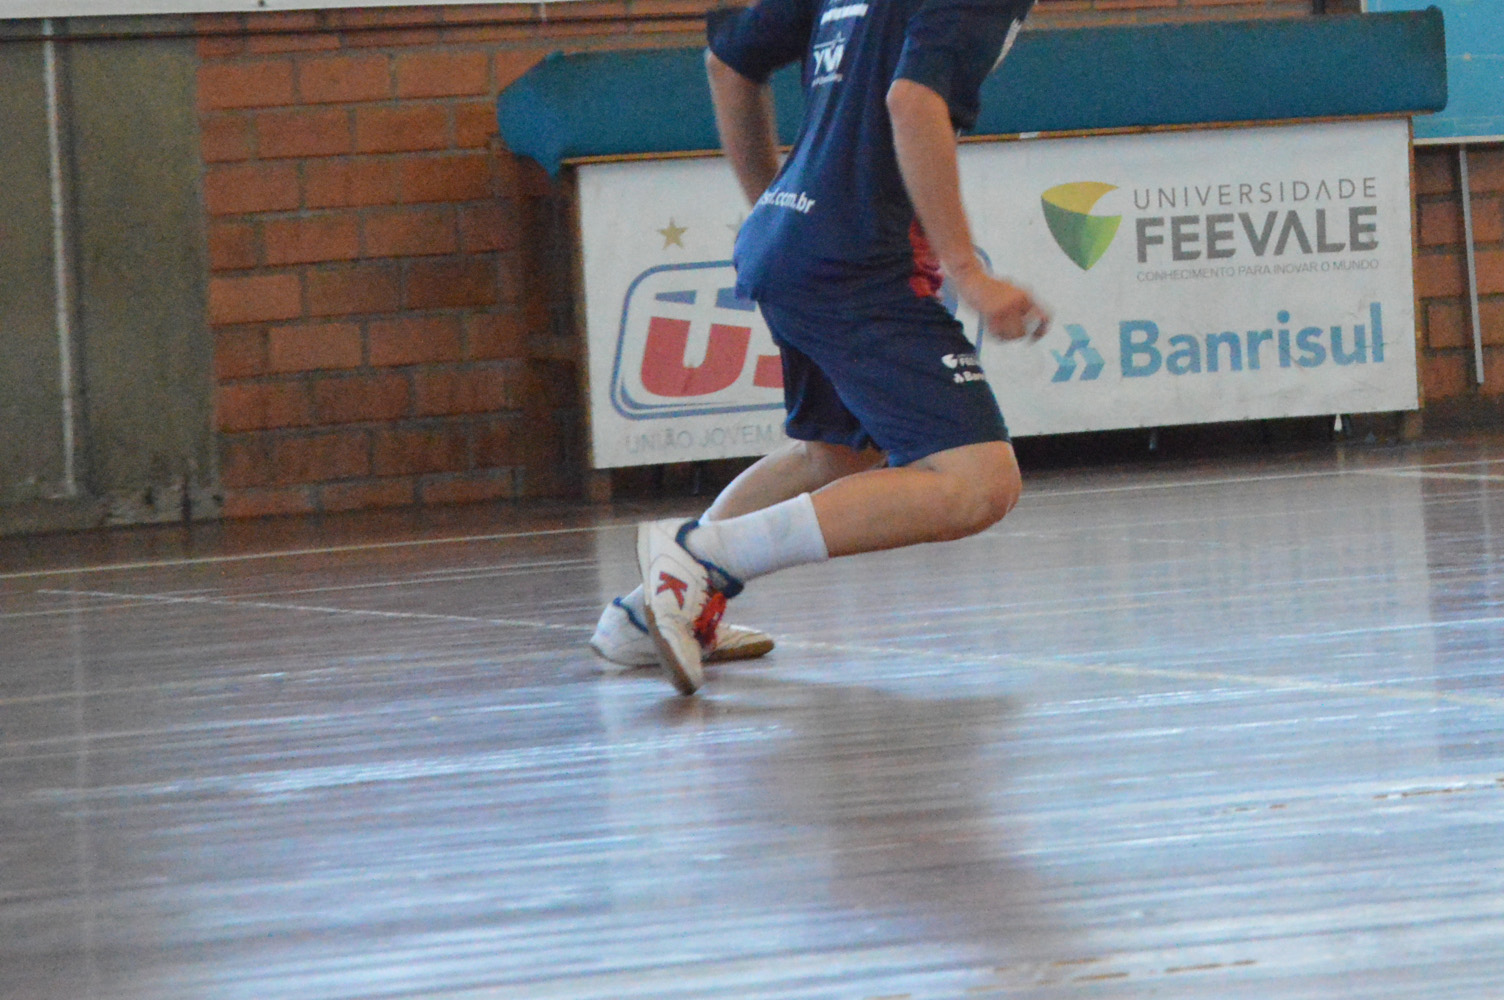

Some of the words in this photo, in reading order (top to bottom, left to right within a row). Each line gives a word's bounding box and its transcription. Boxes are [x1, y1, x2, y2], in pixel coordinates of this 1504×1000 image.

[1133, 177, 1378, 211] UNIVERSIDADE
[1135, 206, 1380, 263] FEEVALE
[1136, 265, 1236, 283] CONHECIMENTO
[1238, 263, 1271, 276] PARA
[1273, 261, 1318, 275] INOVAR
[1320, 260, 1331, 272] O
[1332, 258, 1379, 272] MUNDO
[1119, 302, 1385, 378] Banrisul
